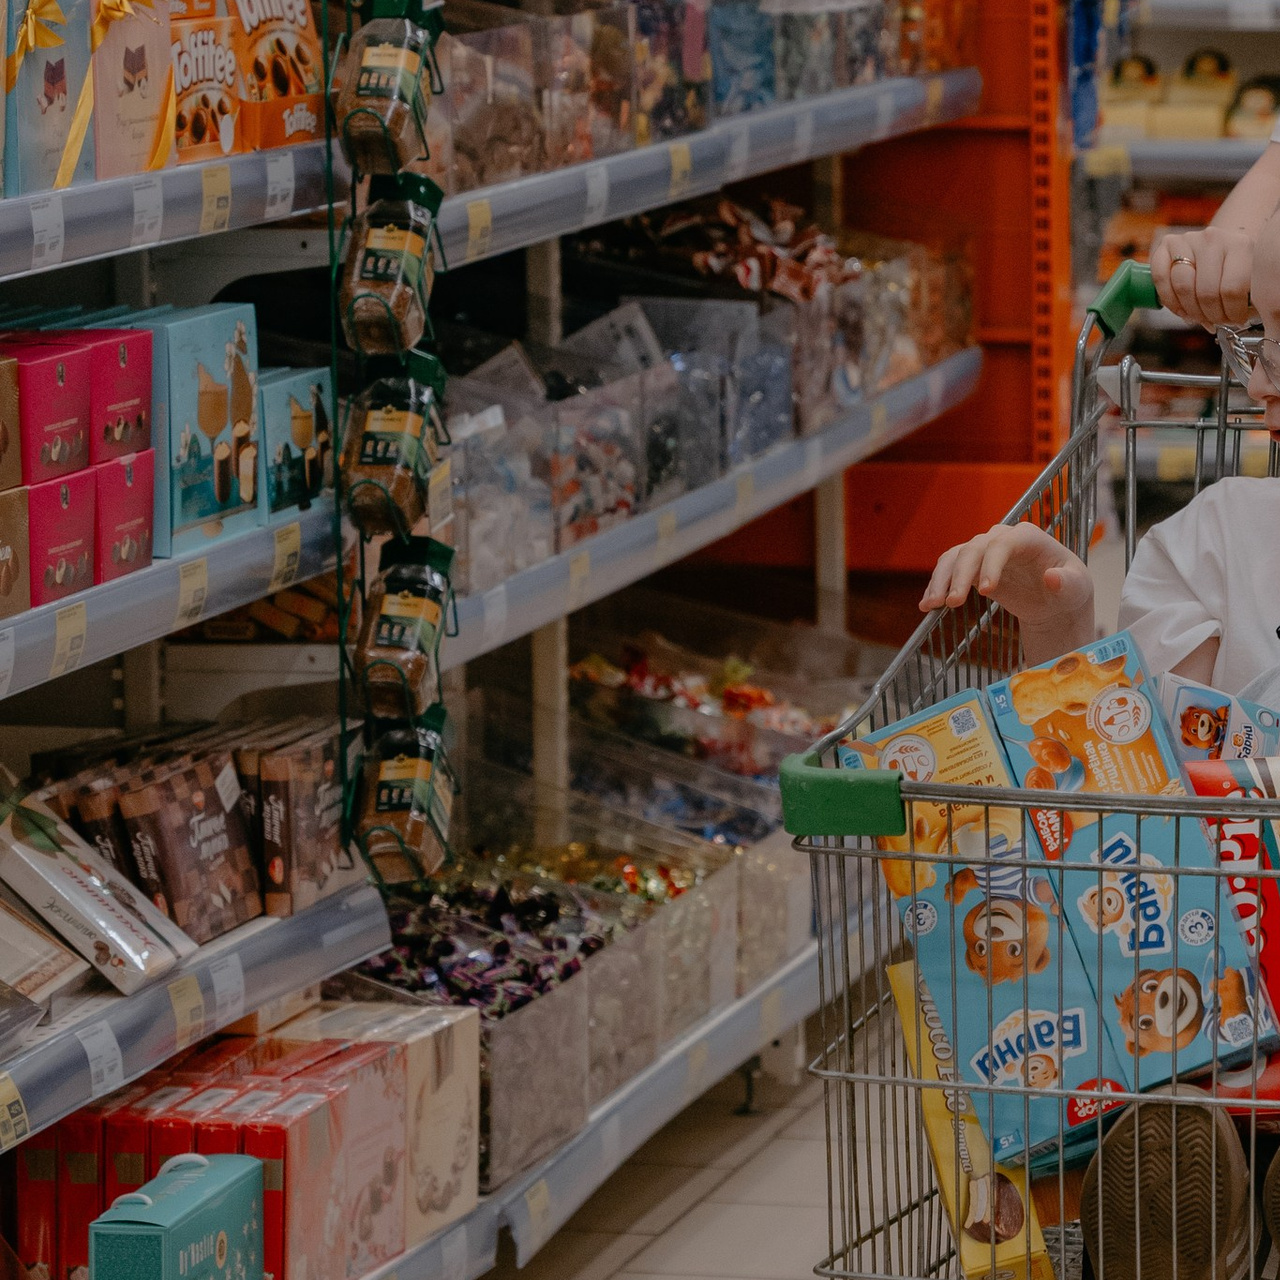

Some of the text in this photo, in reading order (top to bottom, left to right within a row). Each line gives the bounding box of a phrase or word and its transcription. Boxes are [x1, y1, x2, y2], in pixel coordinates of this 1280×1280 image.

[171, 29, 236, 94] Toffifee
[1100, 837, 1166, 951] Барни
[975, 1013, 1083, 1082] Барни
